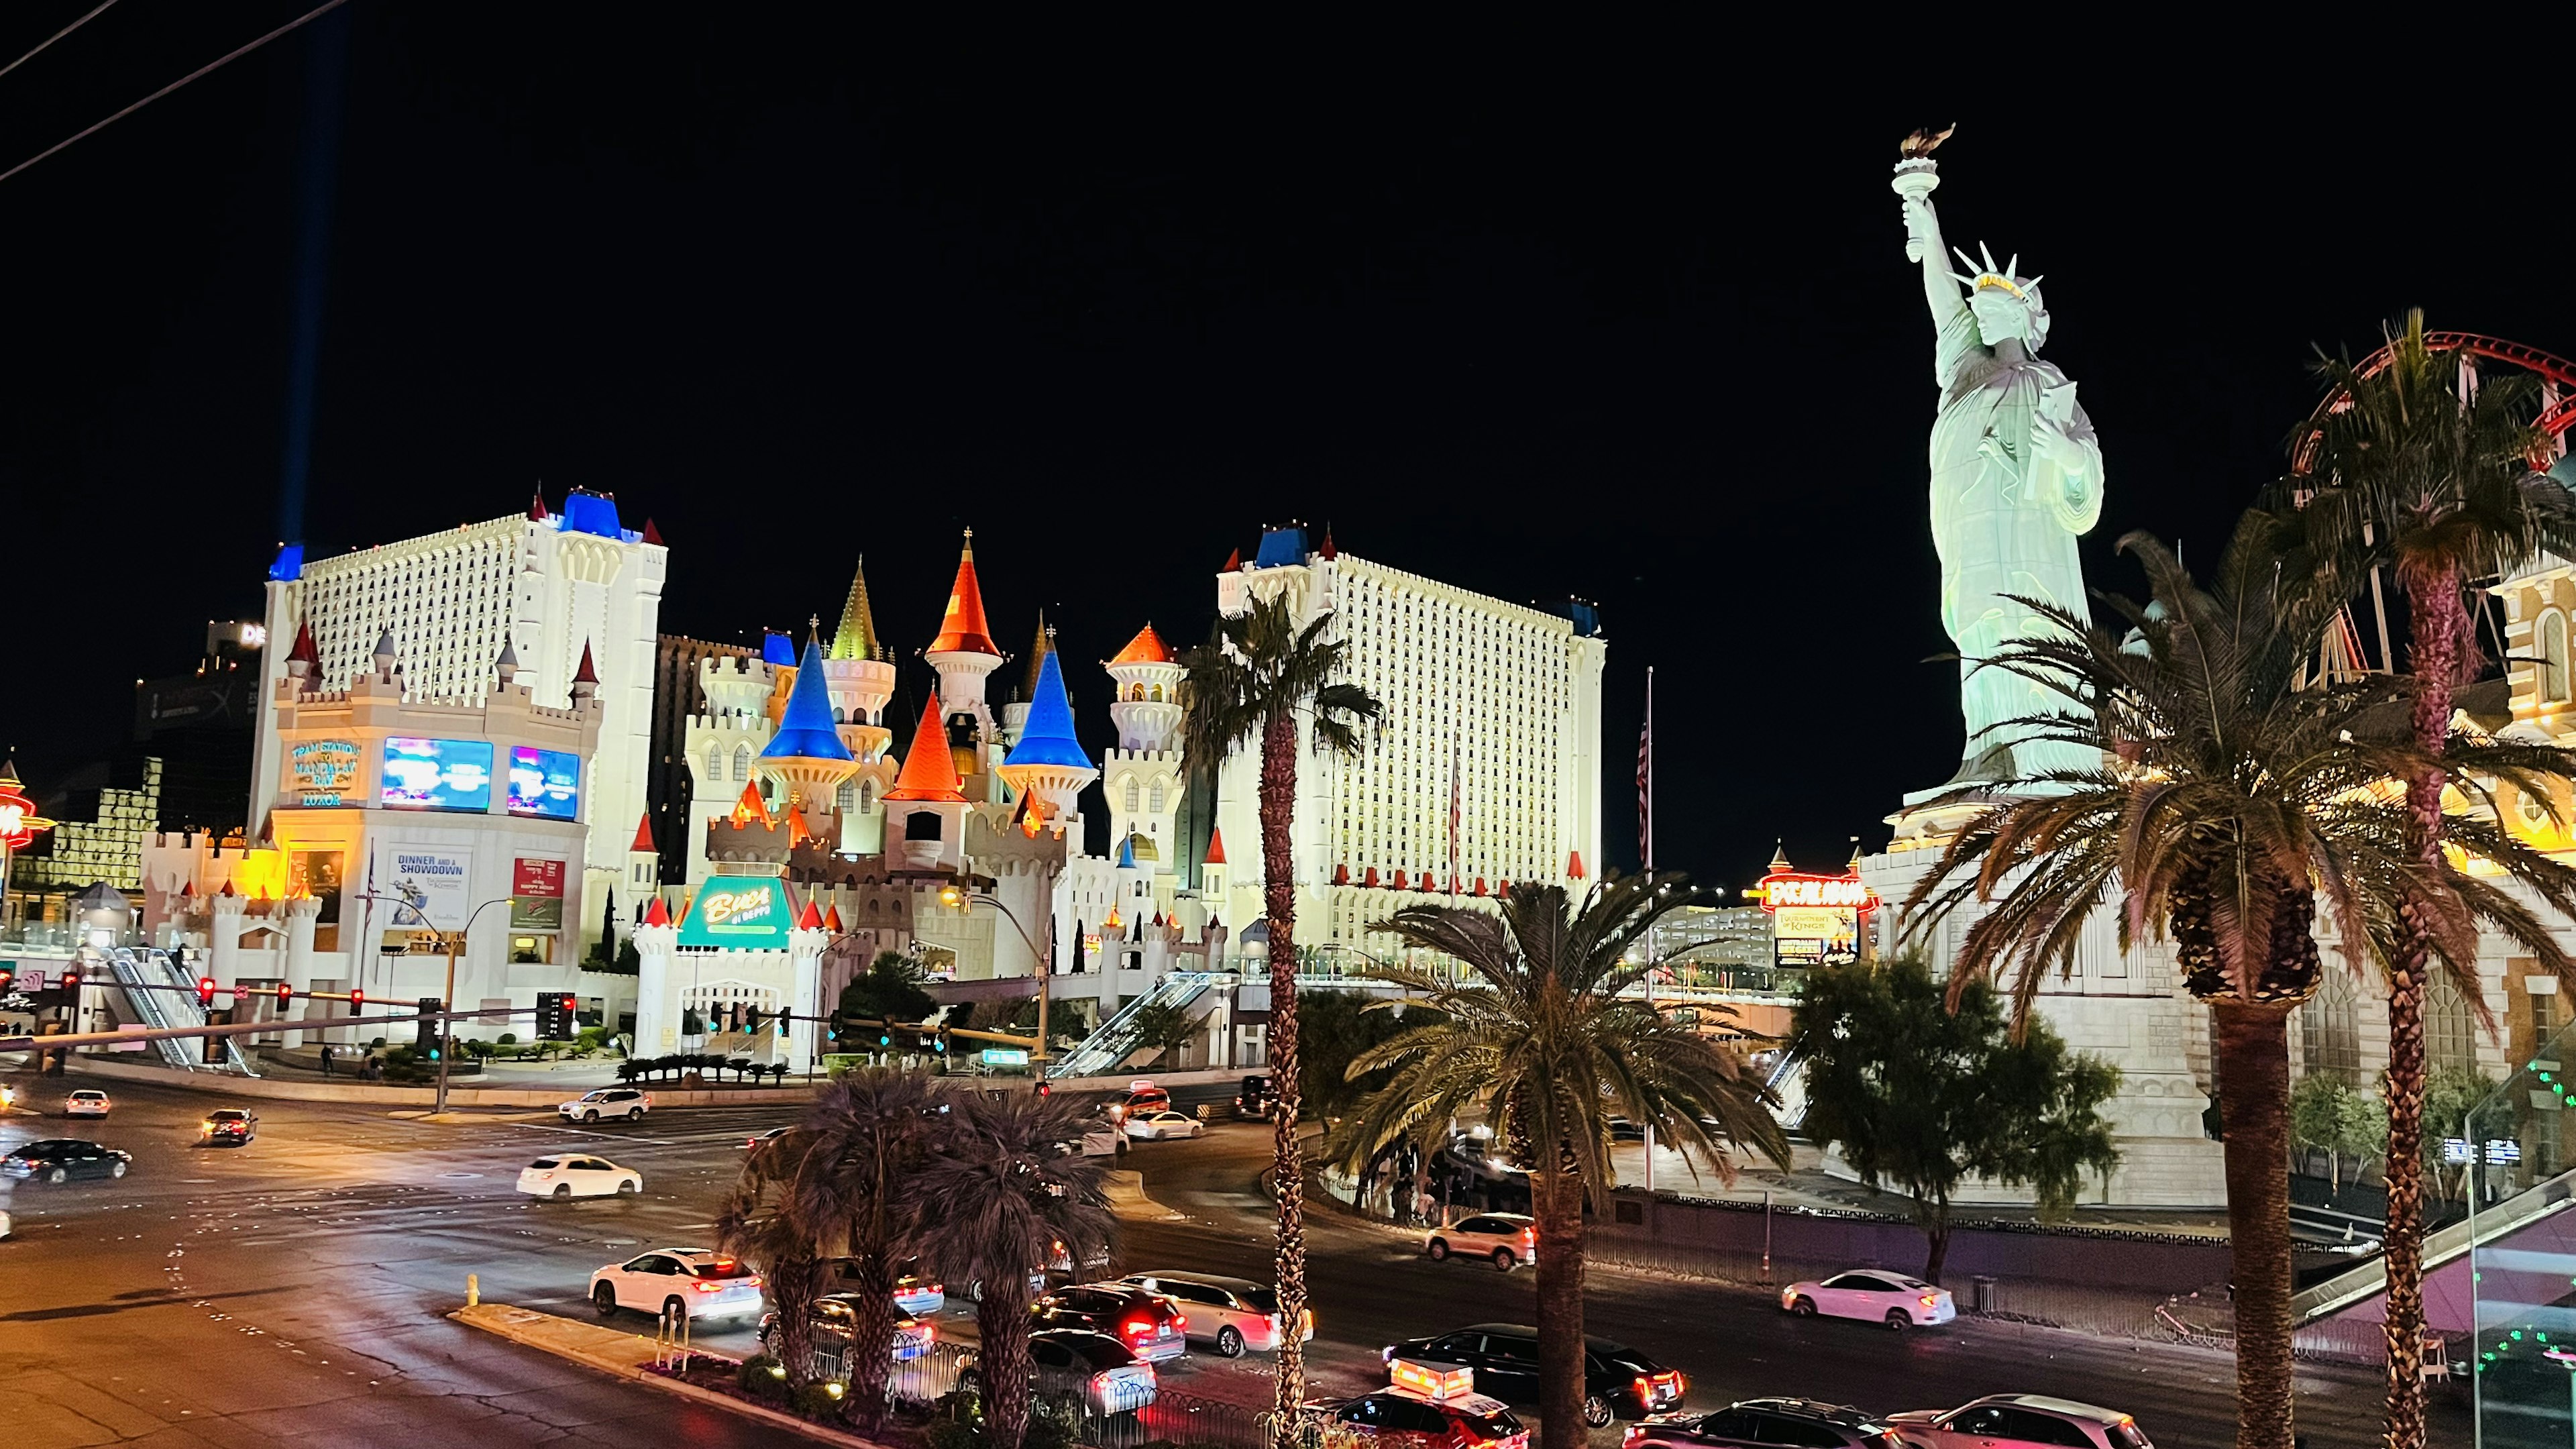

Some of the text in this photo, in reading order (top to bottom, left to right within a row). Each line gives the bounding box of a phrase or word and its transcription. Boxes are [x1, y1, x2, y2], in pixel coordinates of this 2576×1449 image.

[292, 741, 361, 758] TRAM STATION
[295, 761, 356, 773] MANDALAY
[314, 774, 334, 786] BAY
[303, 794, 341, 806] LUXOR
[398, 855, 435, 865] DINNER
[400, 865, 462, 875] SHOWDOWN
[742, 905, 771, 921] BEPPO
[1780, 914, 1829, 923] TOURNAMENT
